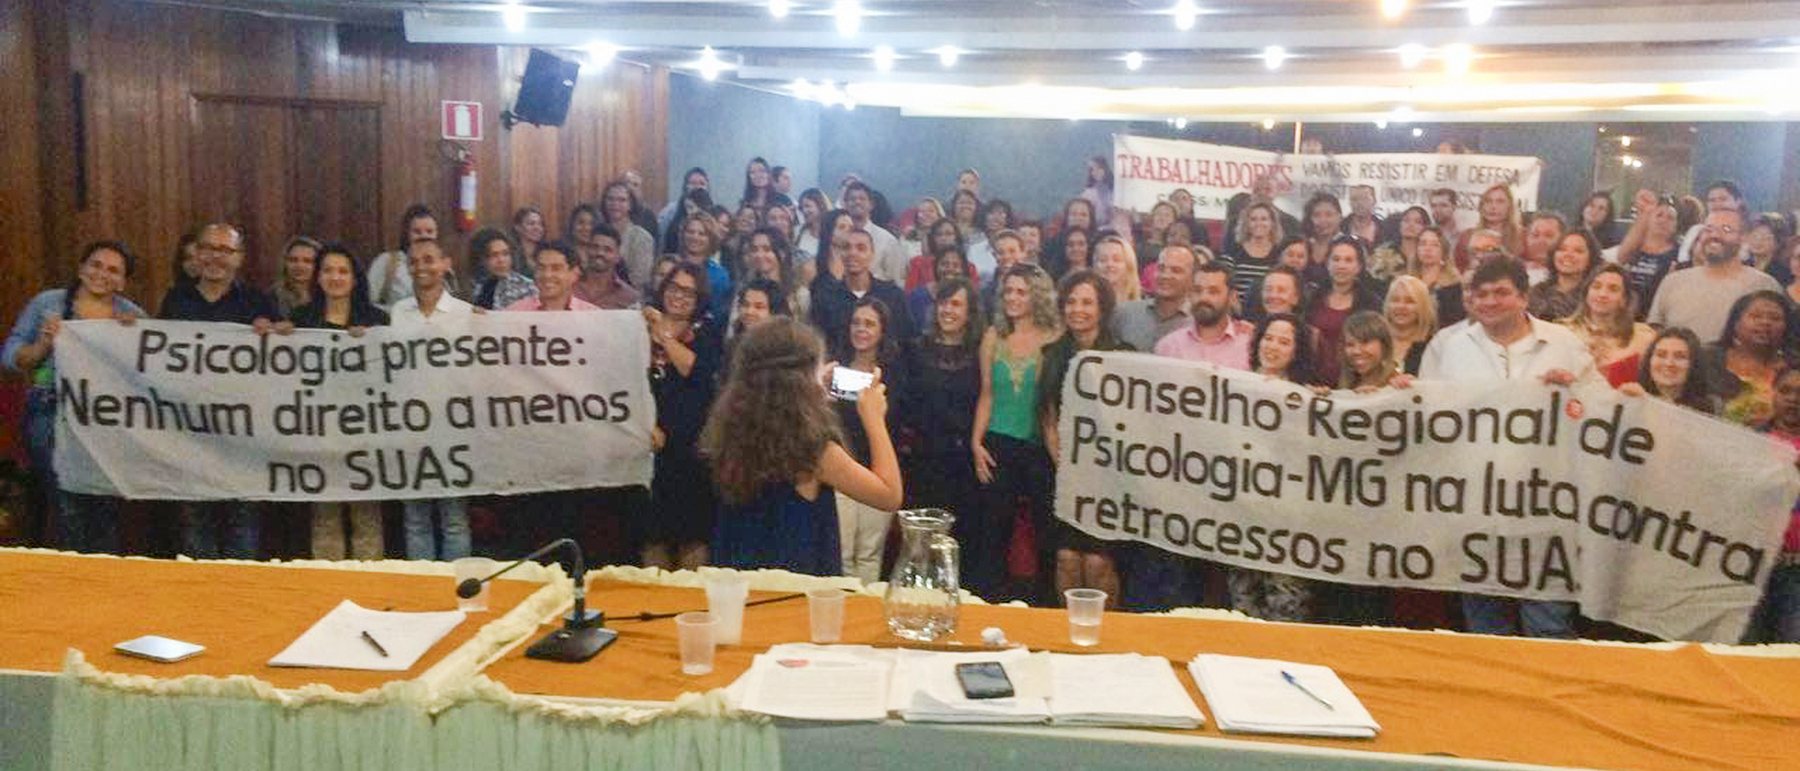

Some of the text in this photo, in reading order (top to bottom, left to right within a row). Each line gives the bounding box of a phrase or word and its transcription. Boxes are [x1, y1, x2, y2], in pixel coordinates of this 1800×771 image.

[1358, 160, 1428, 181] RESISTIR
[1435, 164, 1459, 183] EM
[136, 325, 588, 386] Psicologia presente:
[60, 377, 631, 437] Nenhum direito a menos
[1074, 356, 1655, 465] Conselho Regional de
[268, 445, 475, 494] no SUAS
[1071, 415, 1766, 585] Psicologia-MG na luta contra
[1075, 493, 1582, 593] retrocessos no SUA
